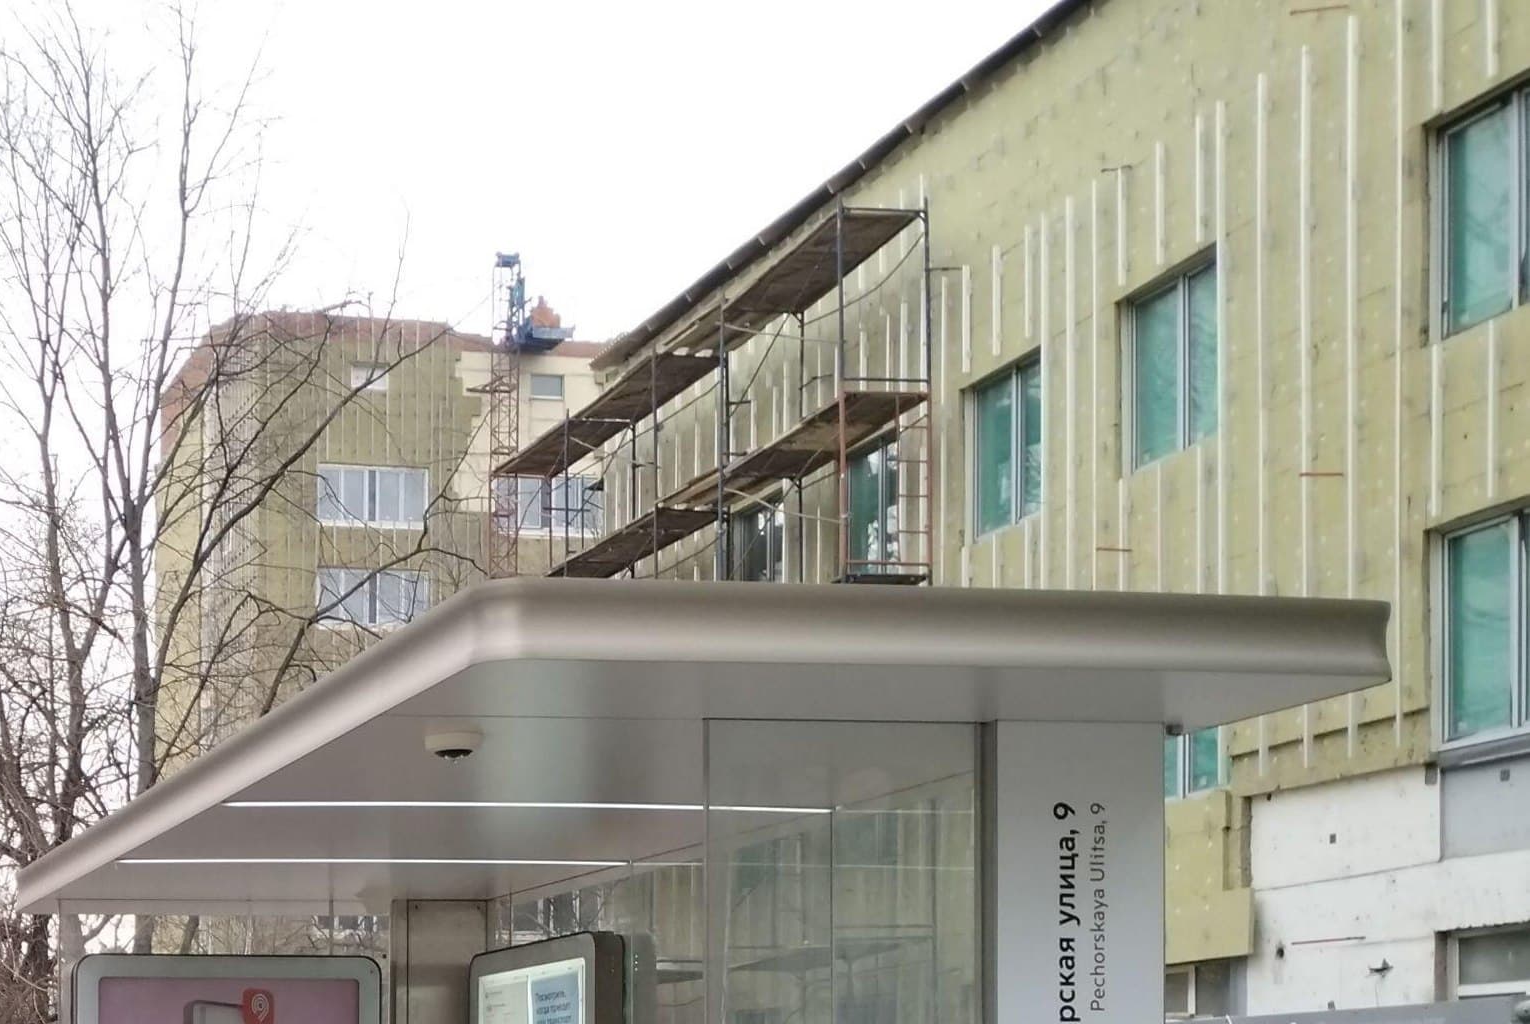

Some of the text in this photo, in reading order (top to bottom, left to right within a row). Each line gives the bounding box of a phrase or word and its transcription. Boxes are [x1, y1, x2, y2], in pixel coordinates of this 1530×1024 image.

[1053, 802, 1076, 820] 9
[1059, 829, 1081, 926] улица,
[1089, 802, 1109, 1011] Pechorskaya Ulitsa, 9
